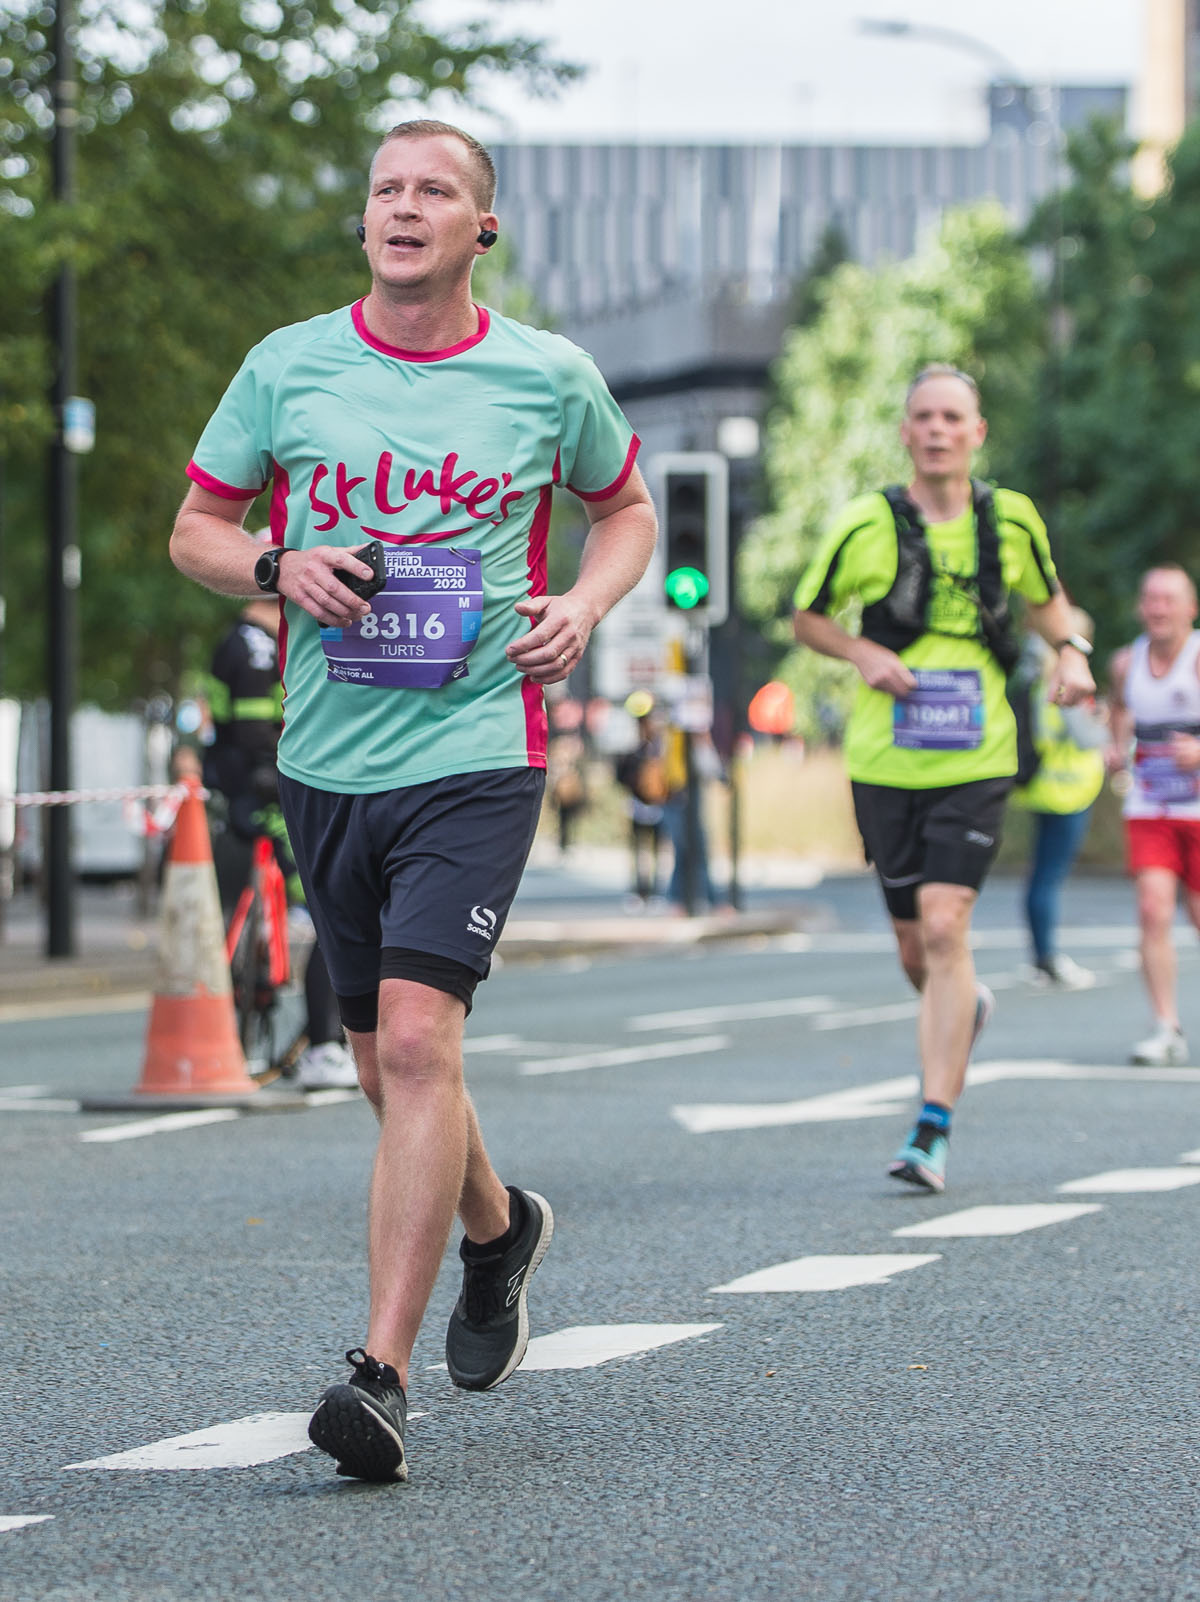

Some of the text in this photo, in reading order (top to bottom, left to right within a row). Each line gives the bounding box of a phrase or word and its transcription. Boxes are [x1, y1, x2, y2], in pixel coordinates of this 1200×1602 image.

[308, 451, 525, 532] St Luke's
[384, 557, 420, 566] FFIELD
[397, 568, 465, 577] MARATHON
[433, 579, 466, 589] 2020
[458, 597, 470, 608] M
[359, 612, 446, 640] 8316
[379, 644, 425, 656] TURTS
